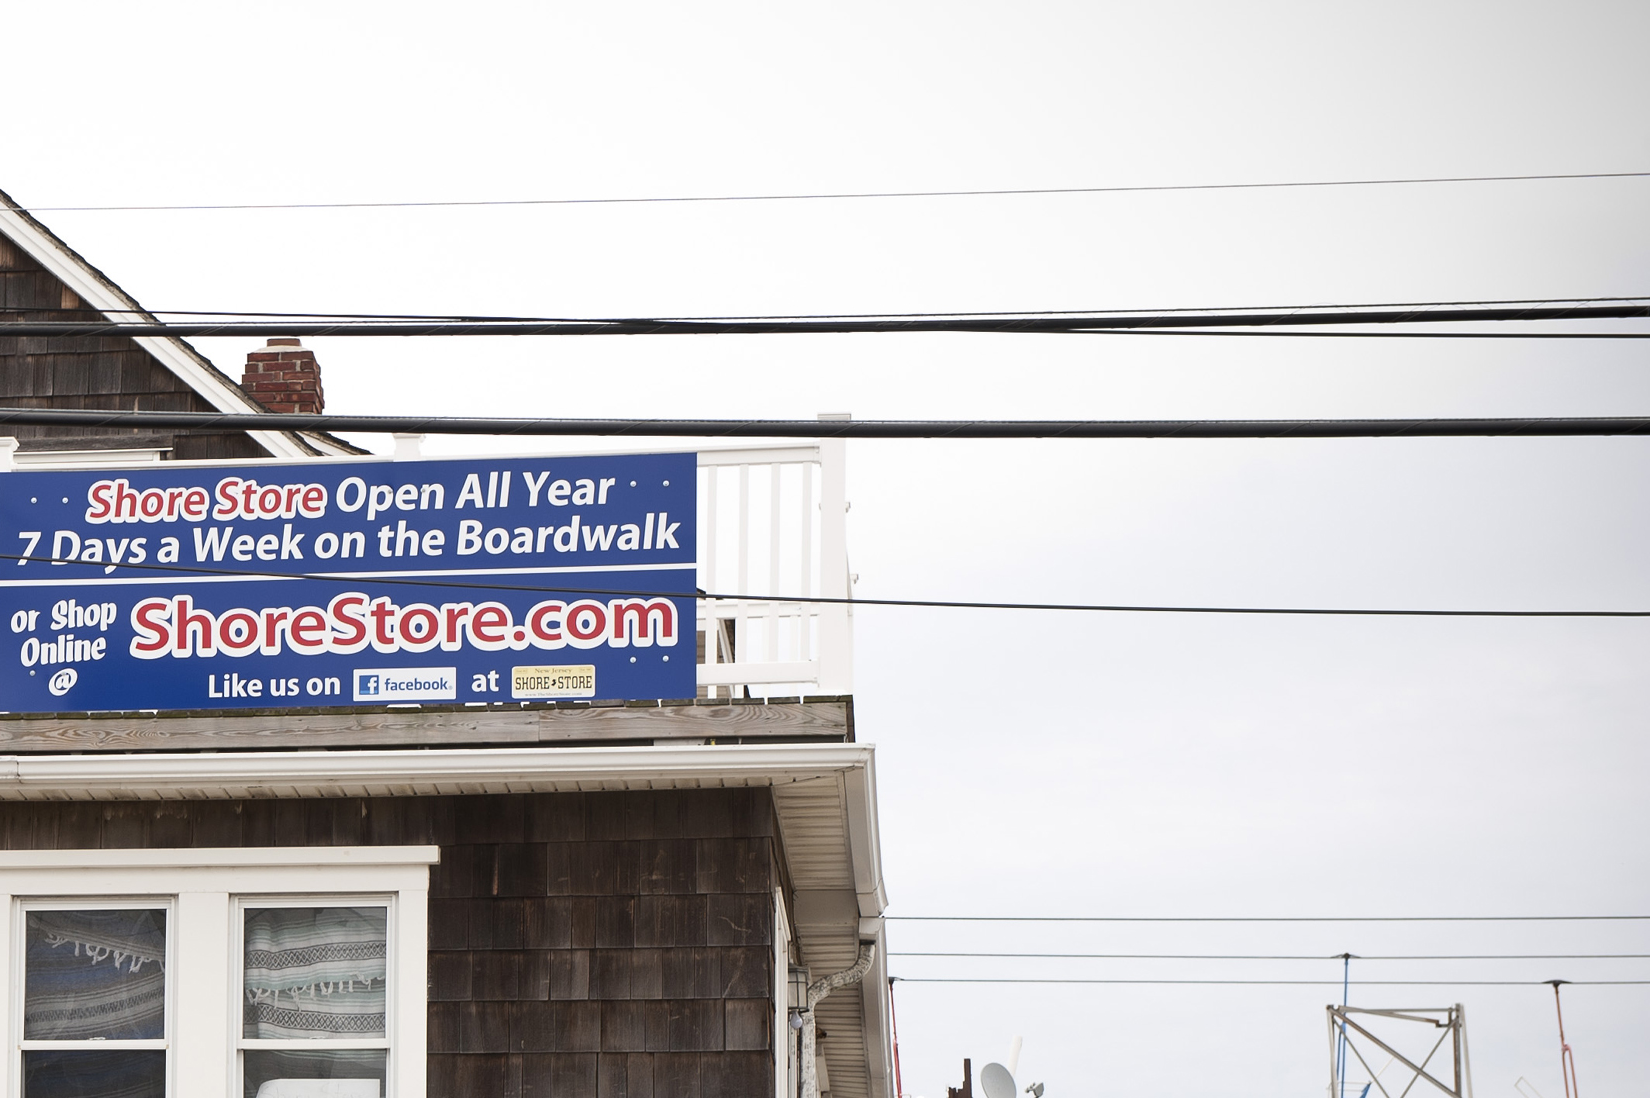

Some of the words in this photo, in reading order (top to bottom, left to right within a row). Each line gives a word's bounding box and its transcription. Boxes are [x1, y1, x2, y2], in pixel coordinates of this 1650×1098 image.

[86, 478, 209, 524] Shore
[213, 477, 327, 520] Store
[336, 476, 445, 521] Open
[454, 471, 511, 509] All
[523, 471, 616, 507] Year
[16, 530, 42, 566] 7
[51, 530, 147, 574] Days
[156, 536, 180, 563] a
[193, 523, 305, 562] Week
[314, 530, 366, 560] on
[377, 520, 445, 557] the
[456, 512, 682, 556] Boardwalk
[10, 608, 41, 634] or
[50, 599, 117, 632] Shop
[130, 592, 678, 660] ShoreStore.com
[20, 634, 106, 667] Online
[208, 673, 263, 699] Like
[270, 677, 299, 697] us
[306, 676, 341, 696] on
[384, 677, 448, 691] facebook
[471, 669, 500, 693] at
[515, 676, 550, 690] SHORE
[557, 675, 593, 689] STORE
